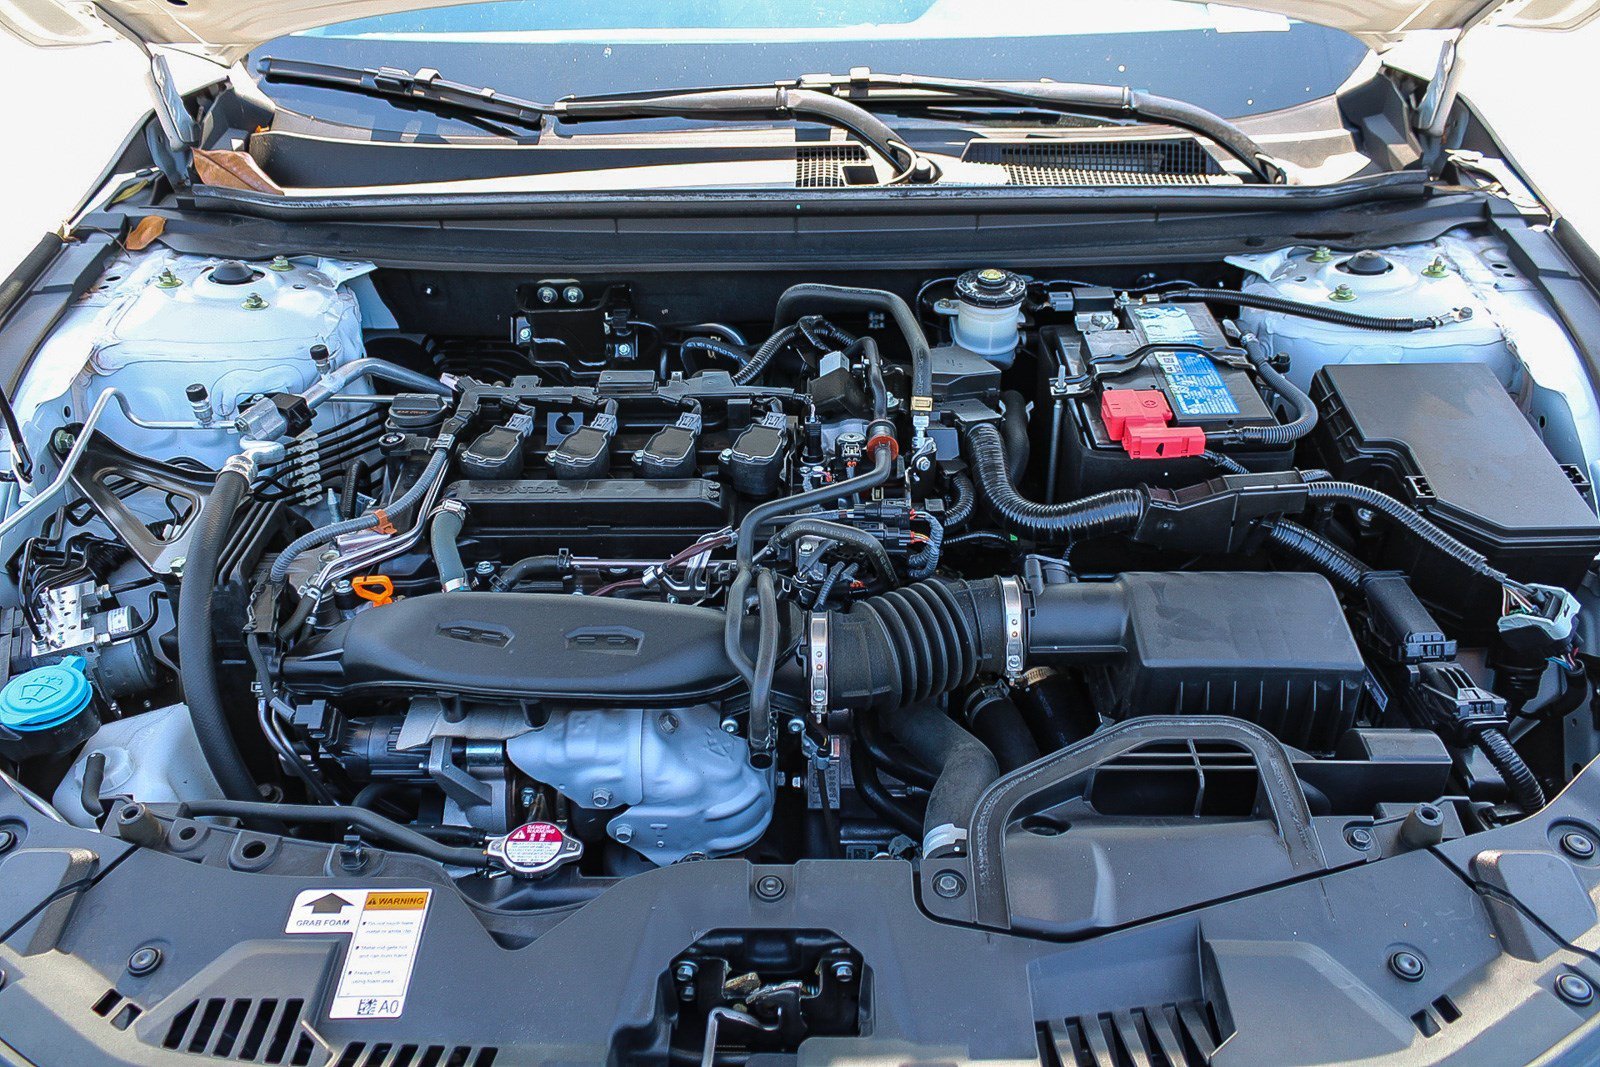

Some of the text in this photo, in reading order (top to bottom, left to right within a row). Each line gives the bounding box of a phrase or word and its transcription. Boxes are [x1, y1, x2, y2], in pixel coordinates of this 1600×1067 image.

[470, 485, 568, 495] HONDA
[379, 897, 424, 905] WARNING
[296, 919, 322, 927] GRAB
[377, 1000, 399, 1014] A0
